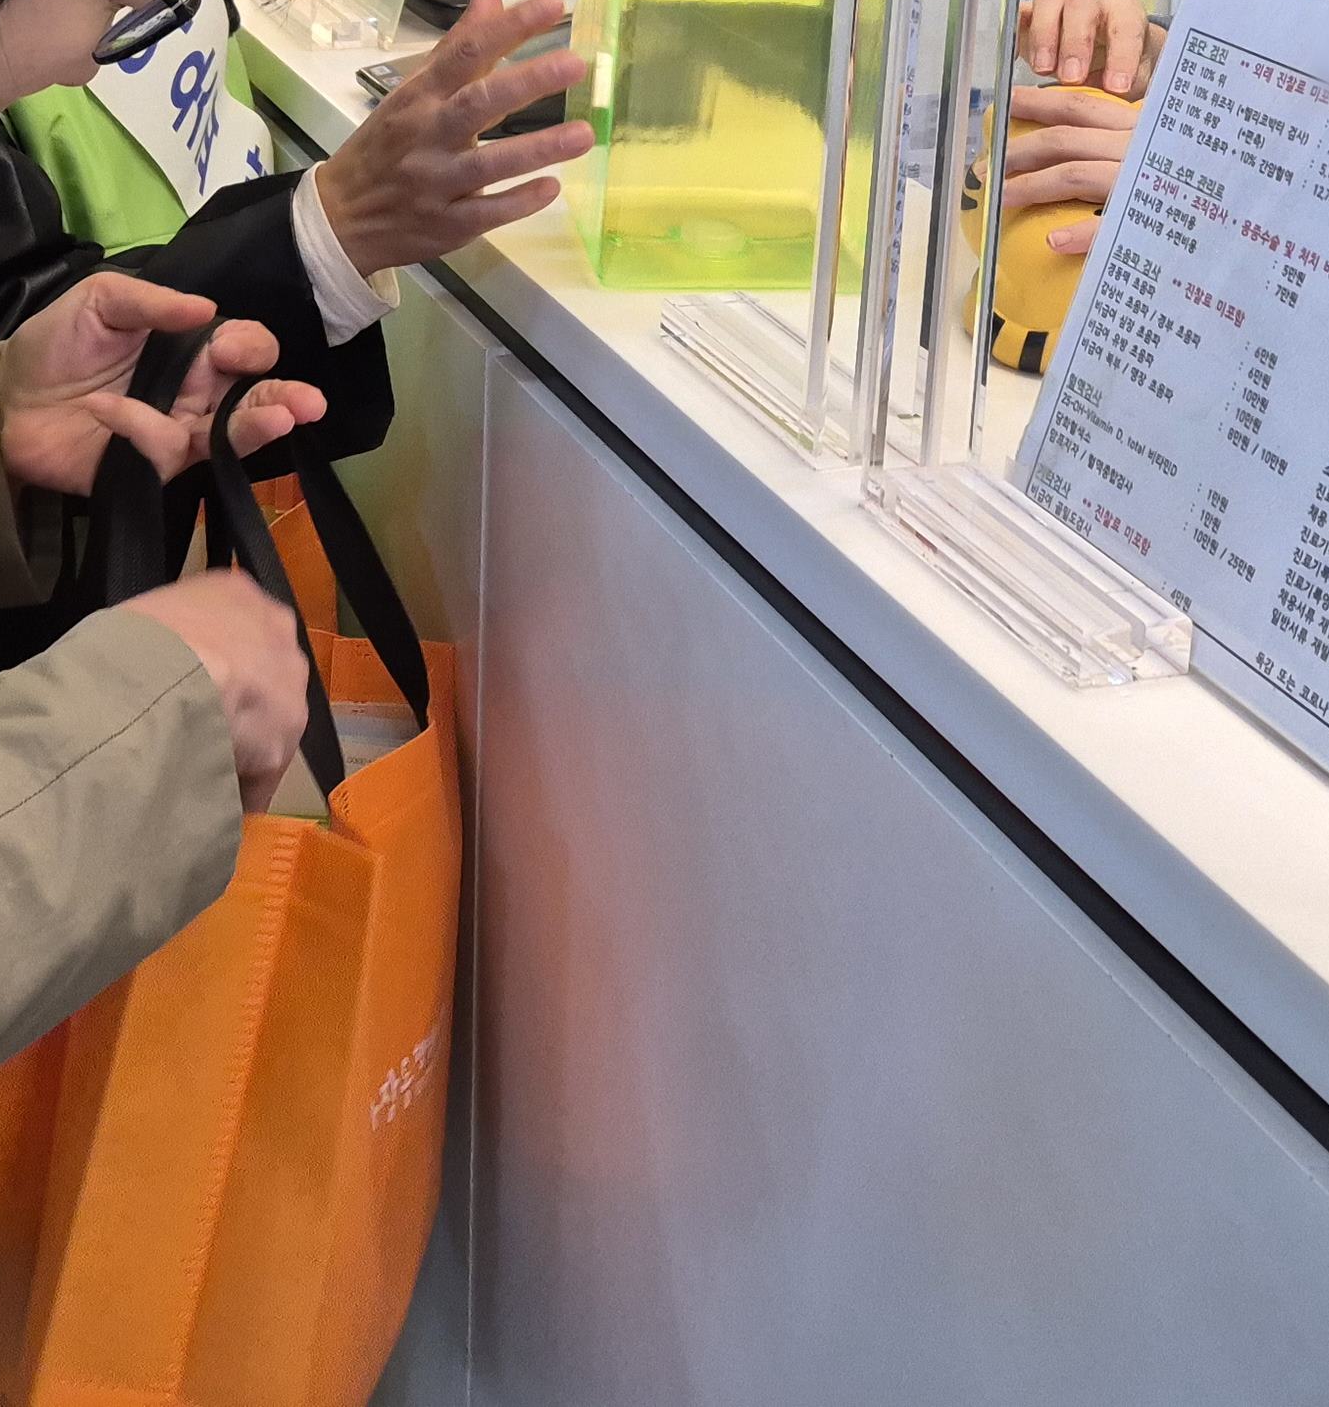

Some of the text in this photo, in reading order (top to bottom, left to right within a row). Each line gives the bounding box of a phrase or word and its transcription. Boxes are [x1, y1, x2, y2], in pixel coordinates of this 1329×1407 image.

[1198, 65, 1217, 83] 10%
[1191, 83, 1210, 102] 10%
[1184, 102, 1203, 120] 10%
[1177, 121, 1196, 140] 10%
[1238, 148, 1258, 168] 10%
[1213, 297, 1247, 330] 미포함
[1305, 501, 1329, 530] 채용
[1121, 523, 1152, 558] 미포함
[1275, 585, 1317, 628] 채용서류
[1268, 605, 1310, 648] 일반서류
[1252, 649, 1275, 678] 독감
[1274, 666, 1298, 695] 또는
[1297, 682, 1329, 718] 코로나
